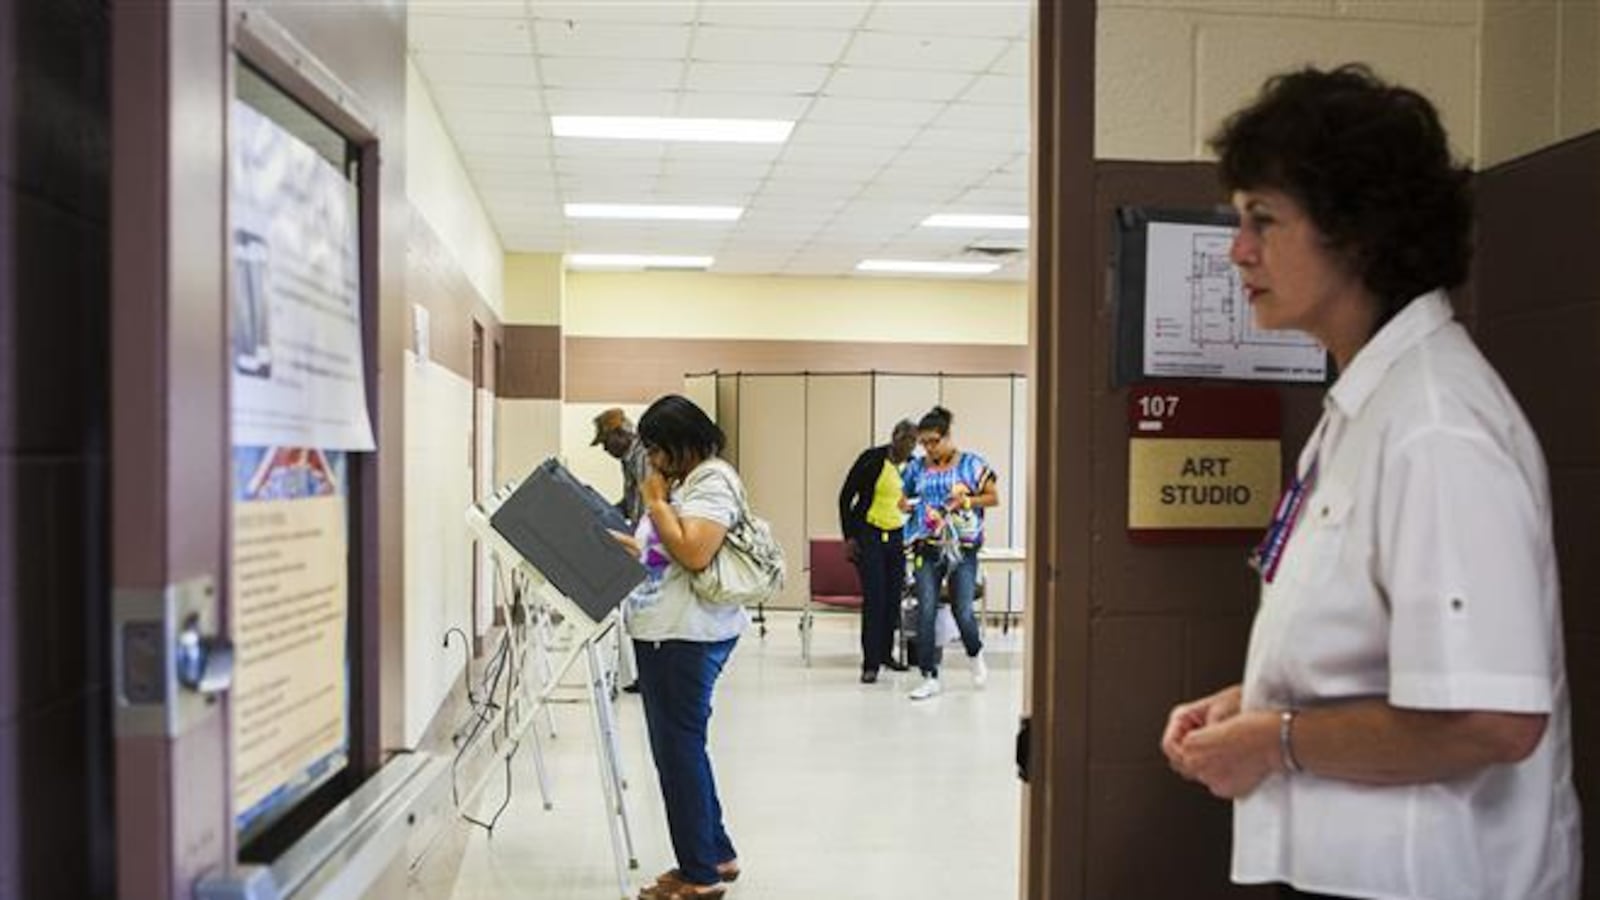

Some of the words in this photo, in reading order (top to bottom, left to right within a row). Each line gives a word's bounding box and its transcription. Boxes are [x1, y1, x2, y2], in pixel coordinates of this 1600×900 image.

[1138, 396, 1179, 417] 107
[1181, 458, 1230, 477] ART
[1161, 486, 1251, 505] STUDIO
